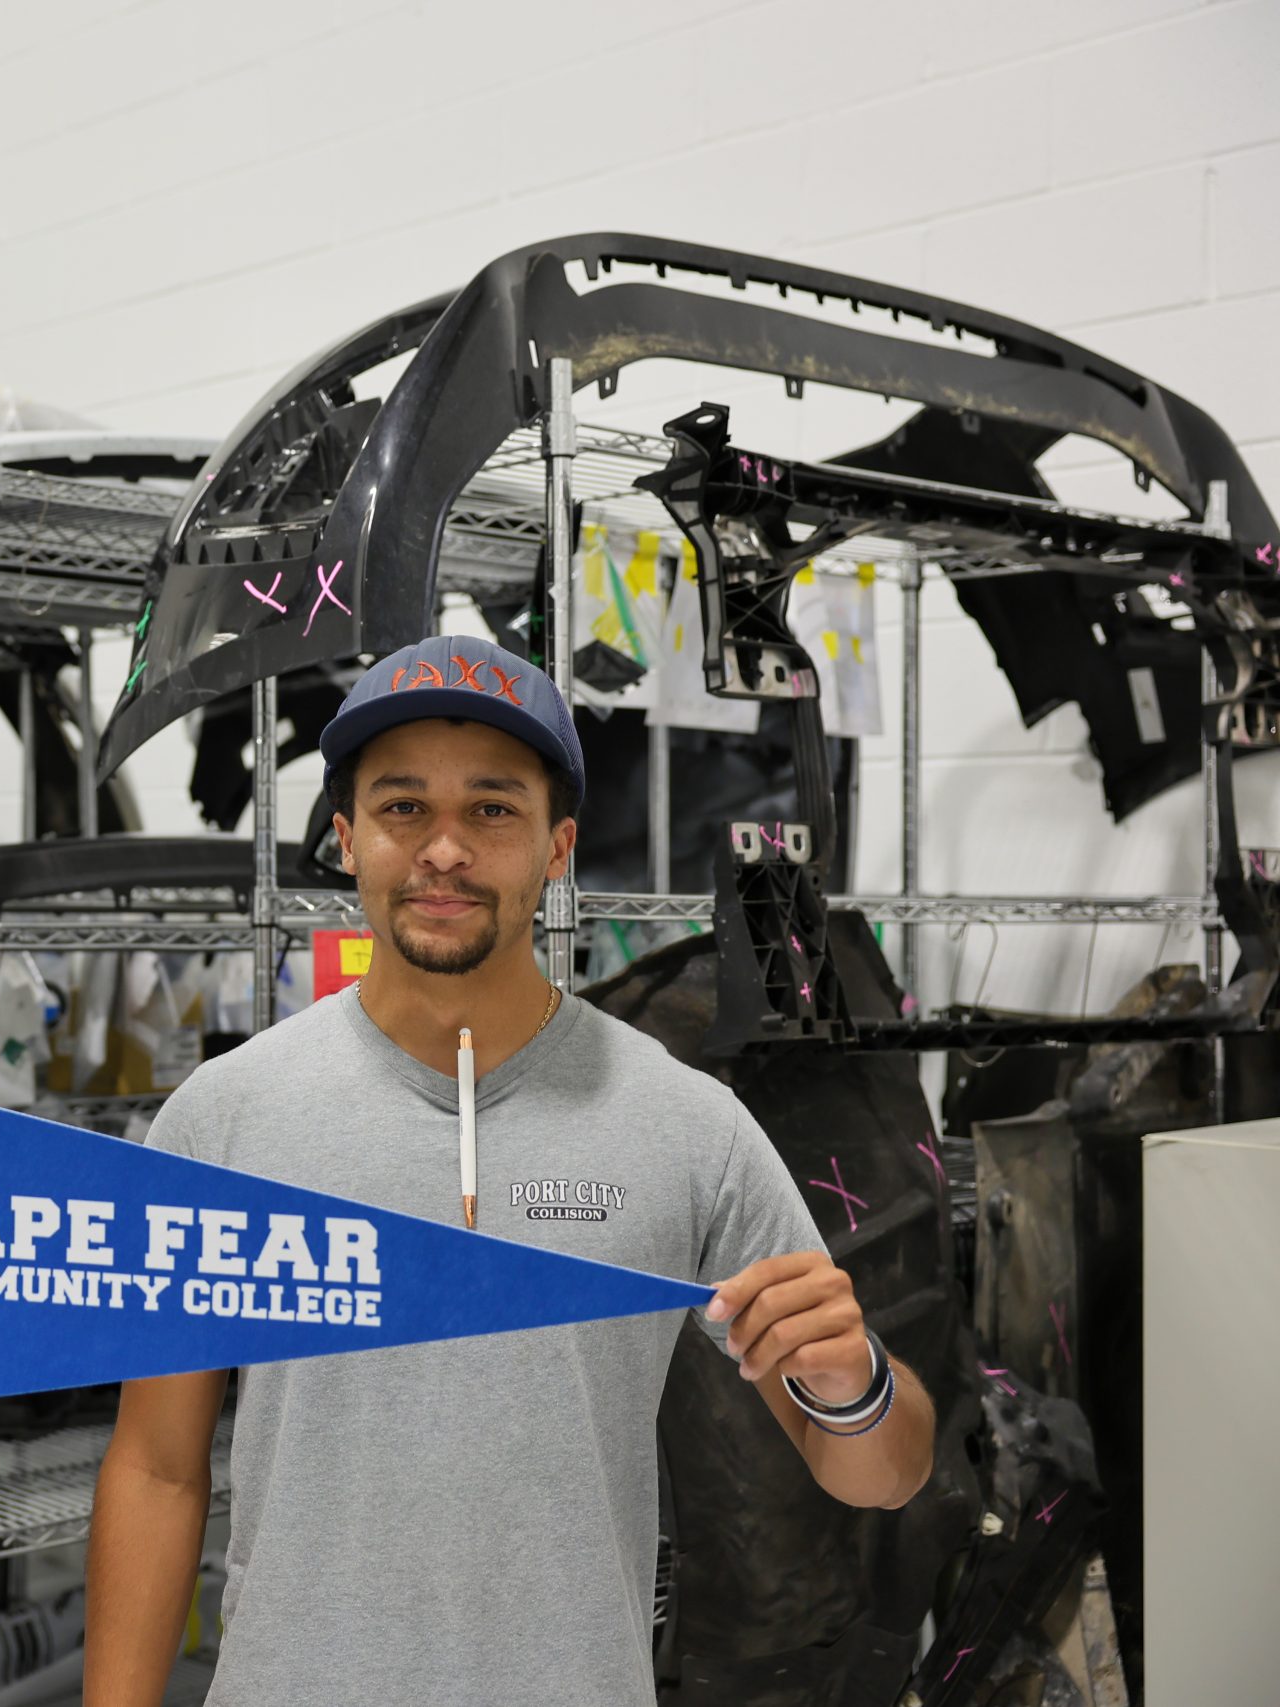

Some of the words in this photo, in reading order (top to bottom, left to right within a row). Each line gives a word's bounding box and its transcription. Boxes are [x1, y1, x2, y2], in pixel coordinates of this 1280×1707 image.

[510, 1179, 569, 1206] PORT
[574, 1180, 626, 1209] CITY
[530, 1208, 602, 1220] COLLISION
[145, 1205, 381, 1285] FEAR
[183, 1279, 381, 1327] COLLEGE
